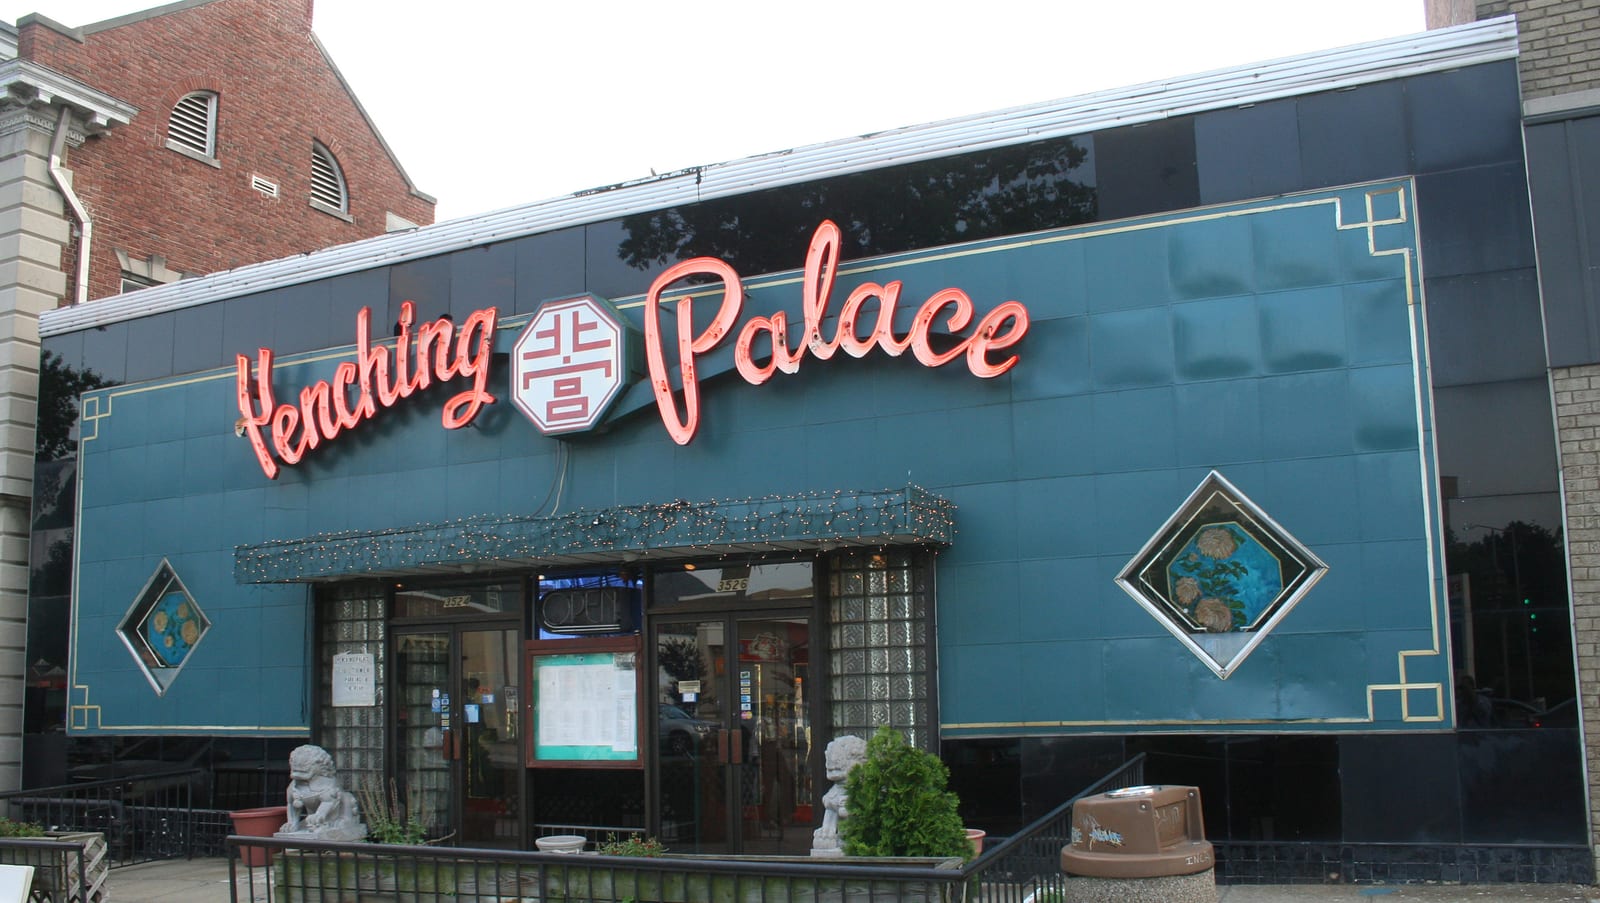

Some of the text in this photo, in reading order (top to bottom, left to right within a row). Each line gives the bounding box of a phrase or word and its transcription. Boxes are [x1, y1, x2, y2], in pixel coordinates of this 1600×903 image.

[236, 219, 1031, 480] Yenching Palace
[717, 579, 748, 591] 3526
[542, 590, 617, 625] OPEN
